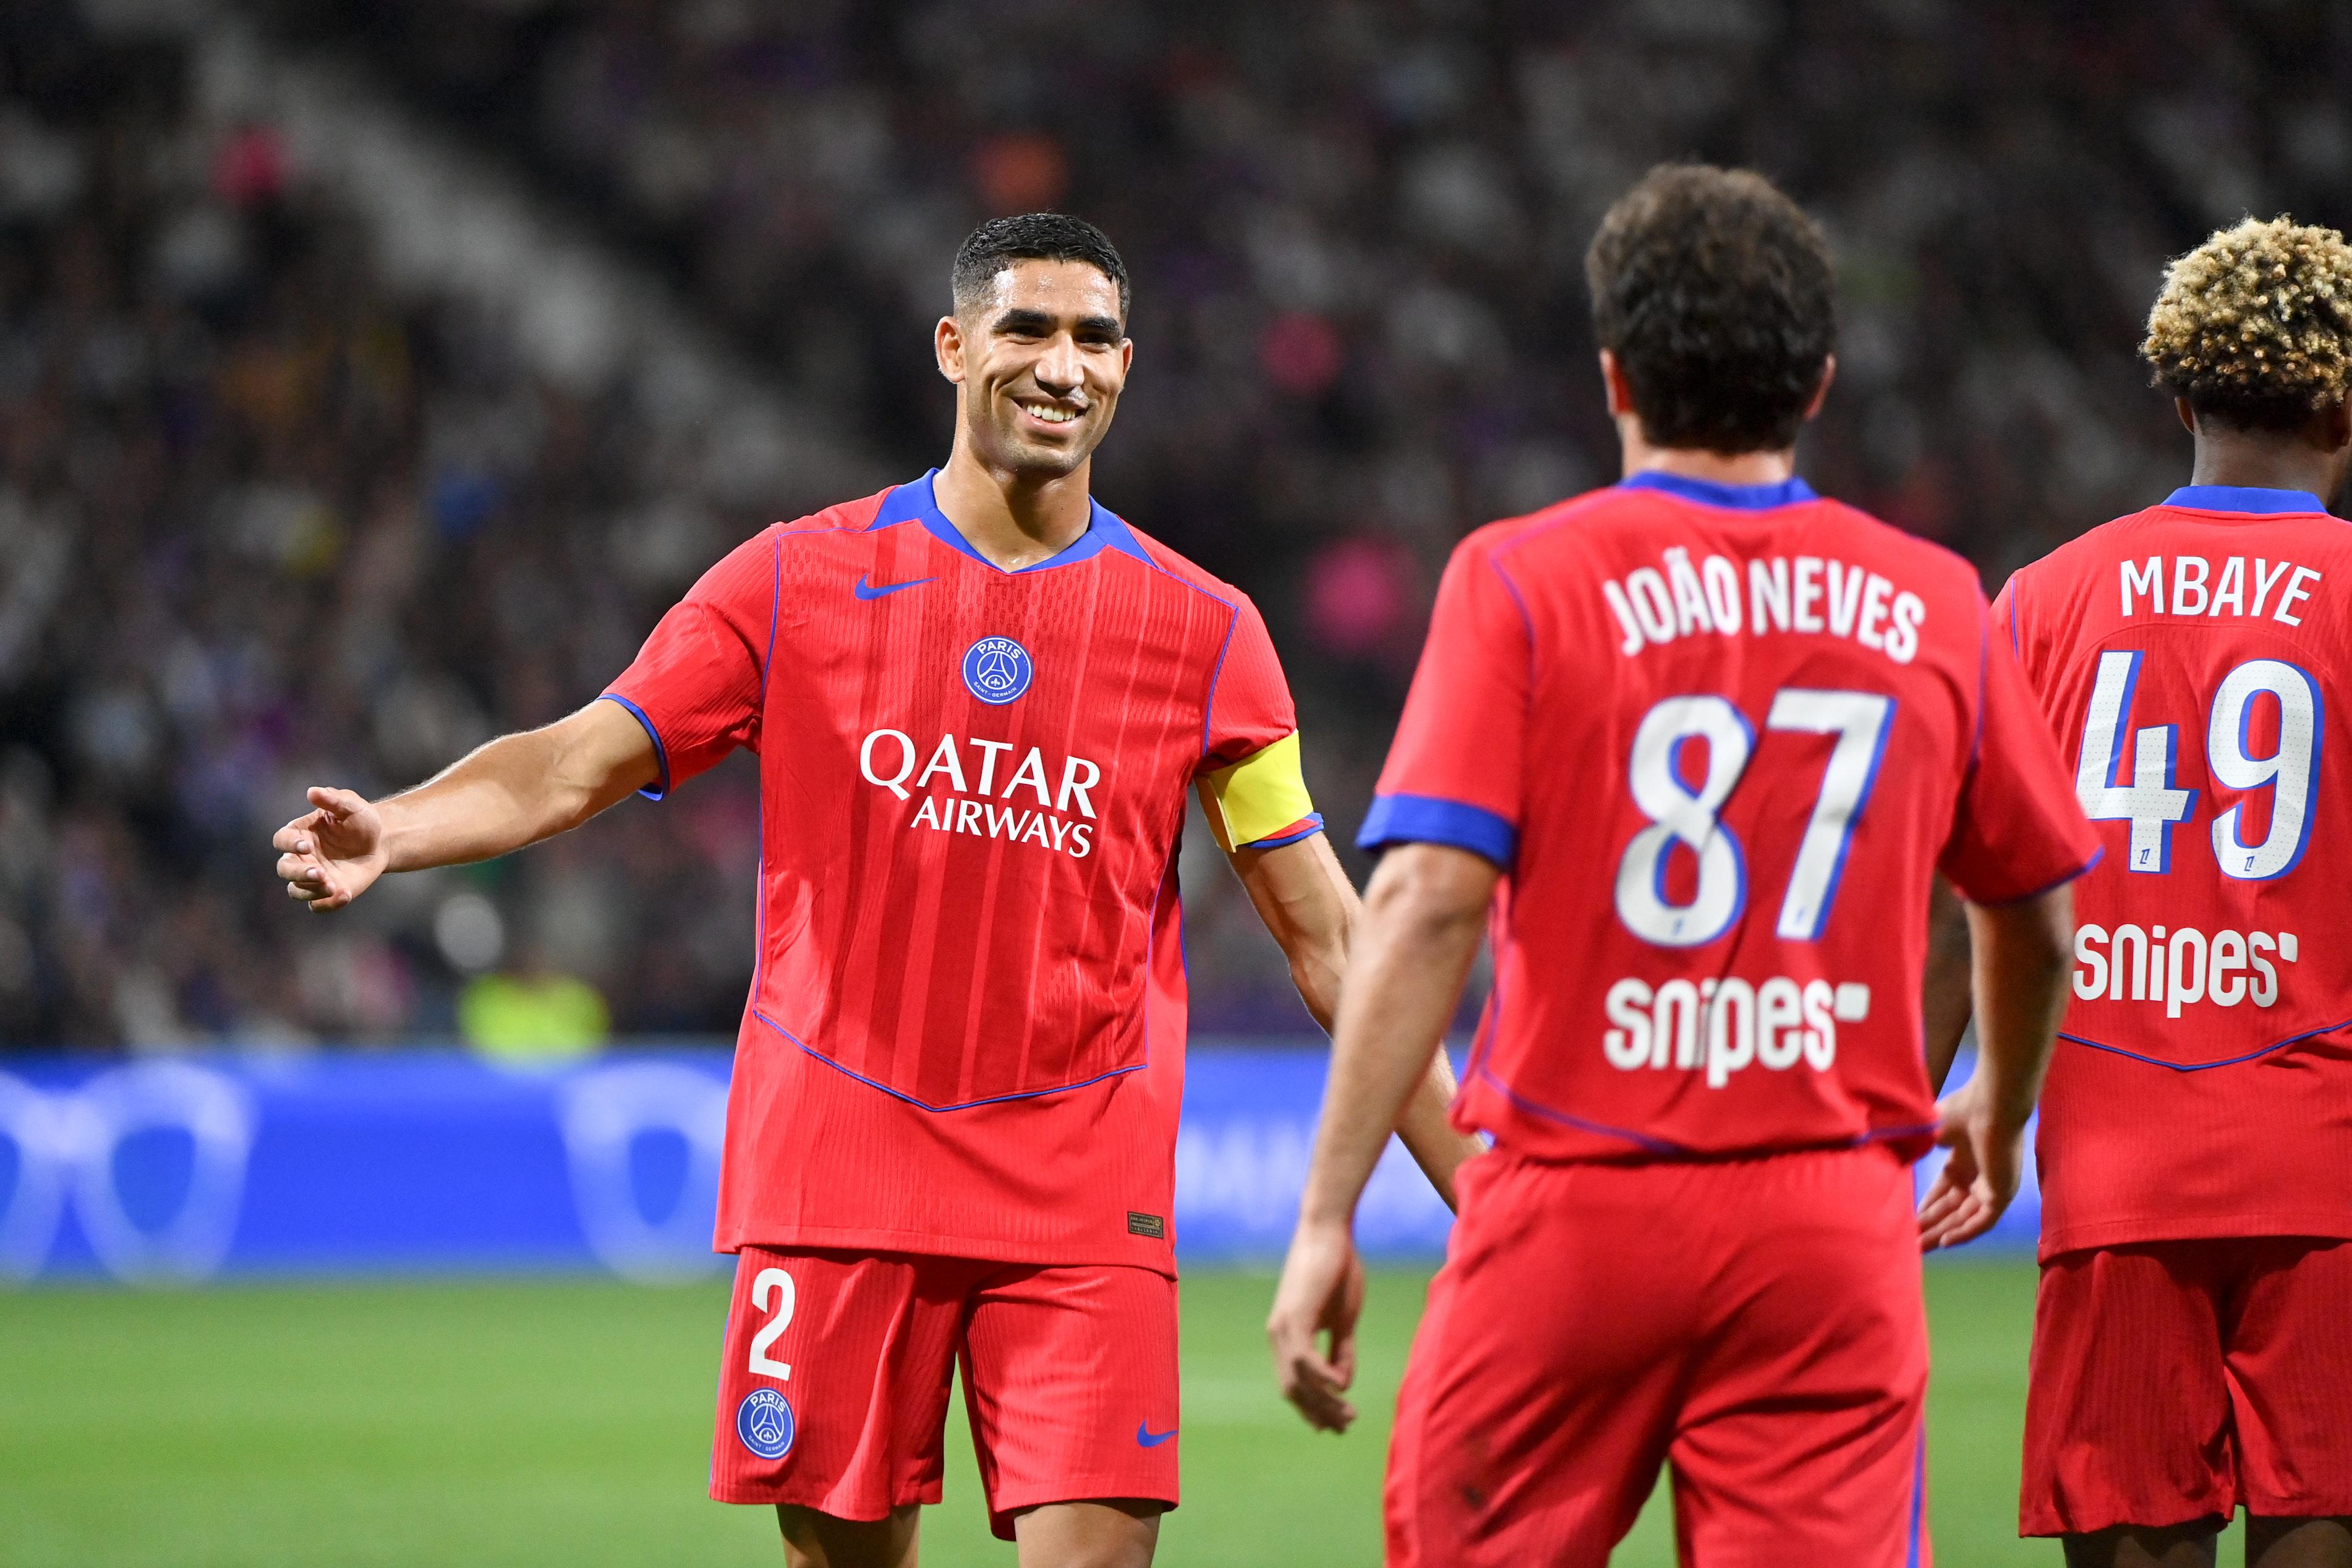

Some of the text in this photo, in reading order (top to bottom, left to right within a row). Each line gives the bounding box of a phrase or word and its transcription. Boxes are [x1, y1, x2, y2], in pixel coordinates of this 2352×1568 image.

[1604, 546, 1926, 665] JOÃO NEVES
[2120, 555, 2322, 627] MBAYE
[977, 641, 1021, 659] PARIS
[859, 728, 1101, 820] QATAR
[2074, 650, 2324, 880] 49
[910, 795, 1094, 858] AIRWAYS
[1614, 688, 1899, 948] 87
[2071, 922, 2278, 1019] snipes
[1603, 977, 1837, 1089] snipes
[748, 1267, 796, 1382] 2
[749, 1393, 786, 1413] PARIS
